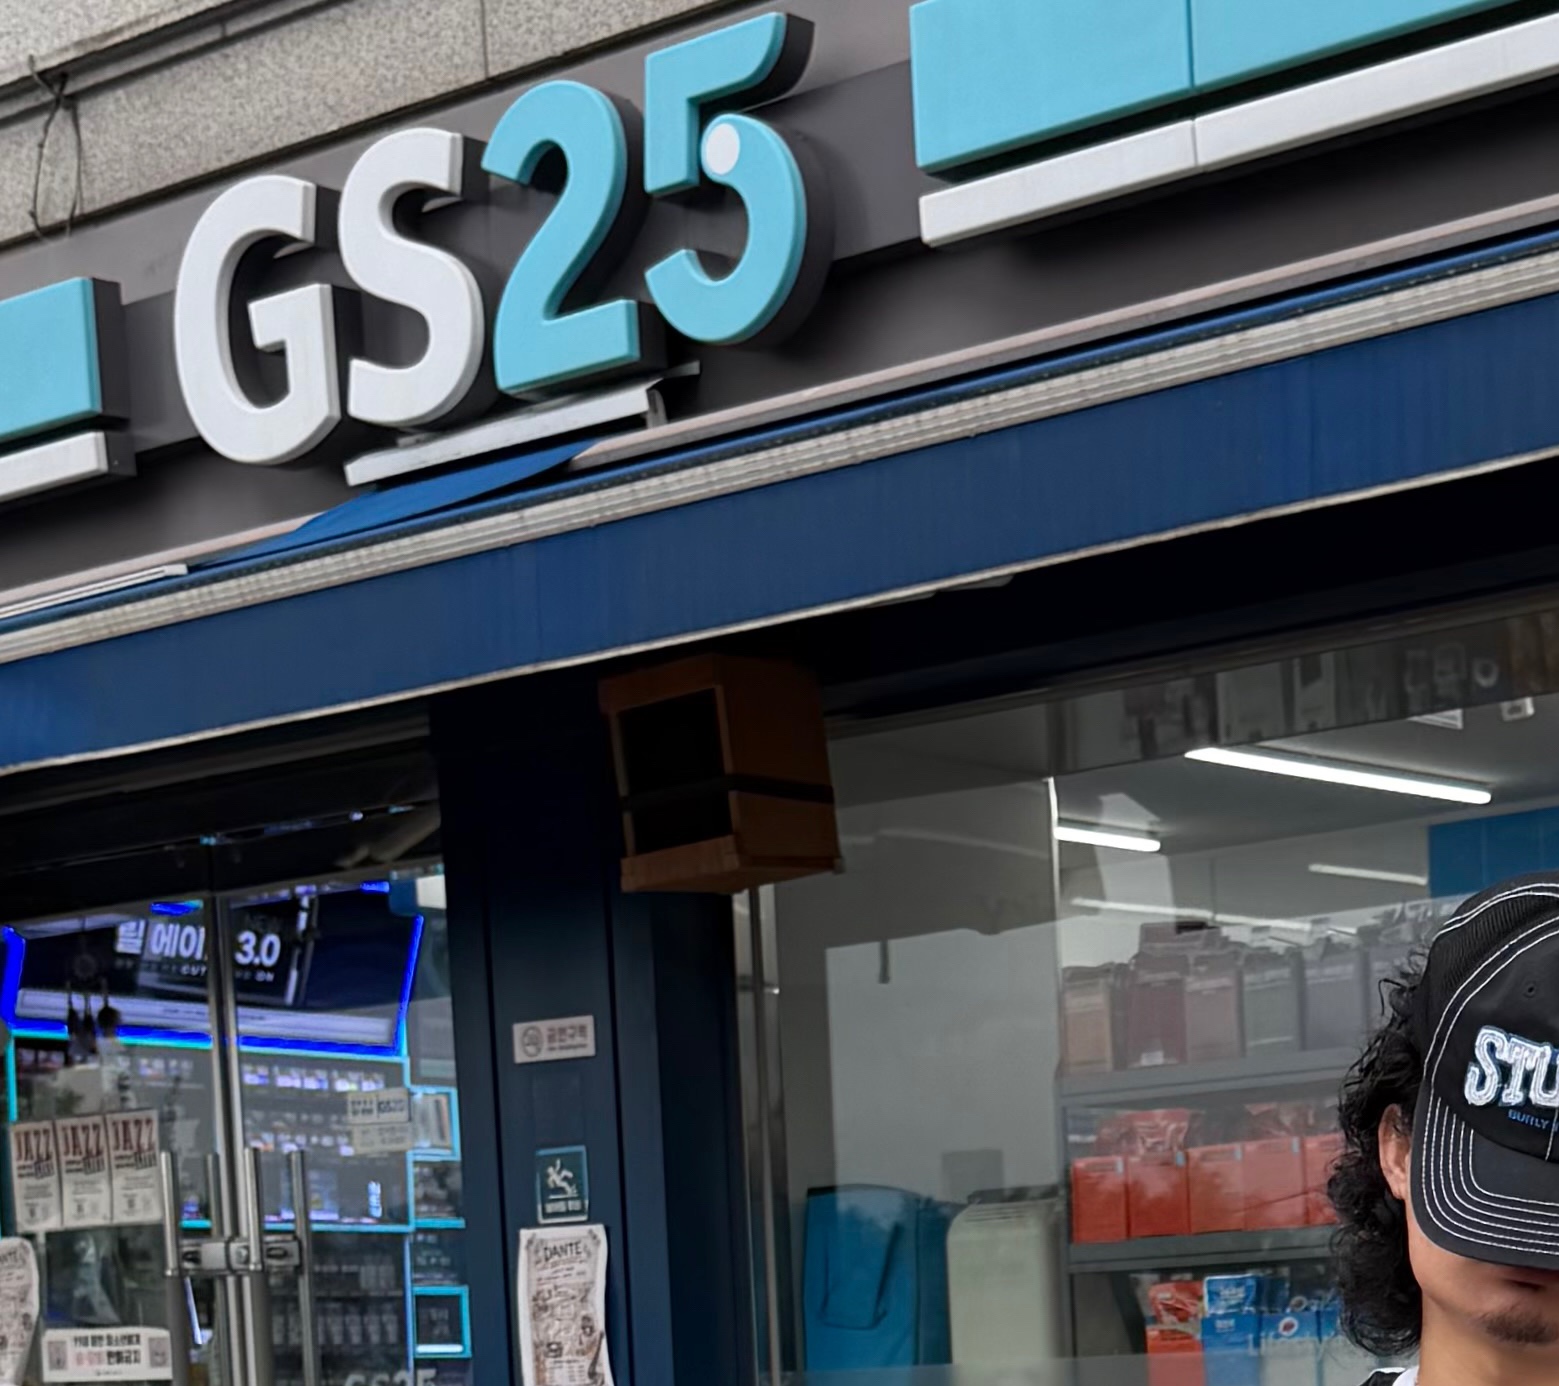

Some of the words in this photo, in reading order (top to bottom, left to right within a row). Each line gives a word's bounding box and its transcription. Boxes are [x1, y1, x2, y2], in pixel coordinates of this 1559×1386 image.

[174, 11, 808, 465] GS25
[235, 930, 281, 968] 3.0
[15, 1128, 53, 1162] JAZZ
[61, 1123, 104, 1157] JAZZ
[111, 1117, 154, 1152] JAZZ
